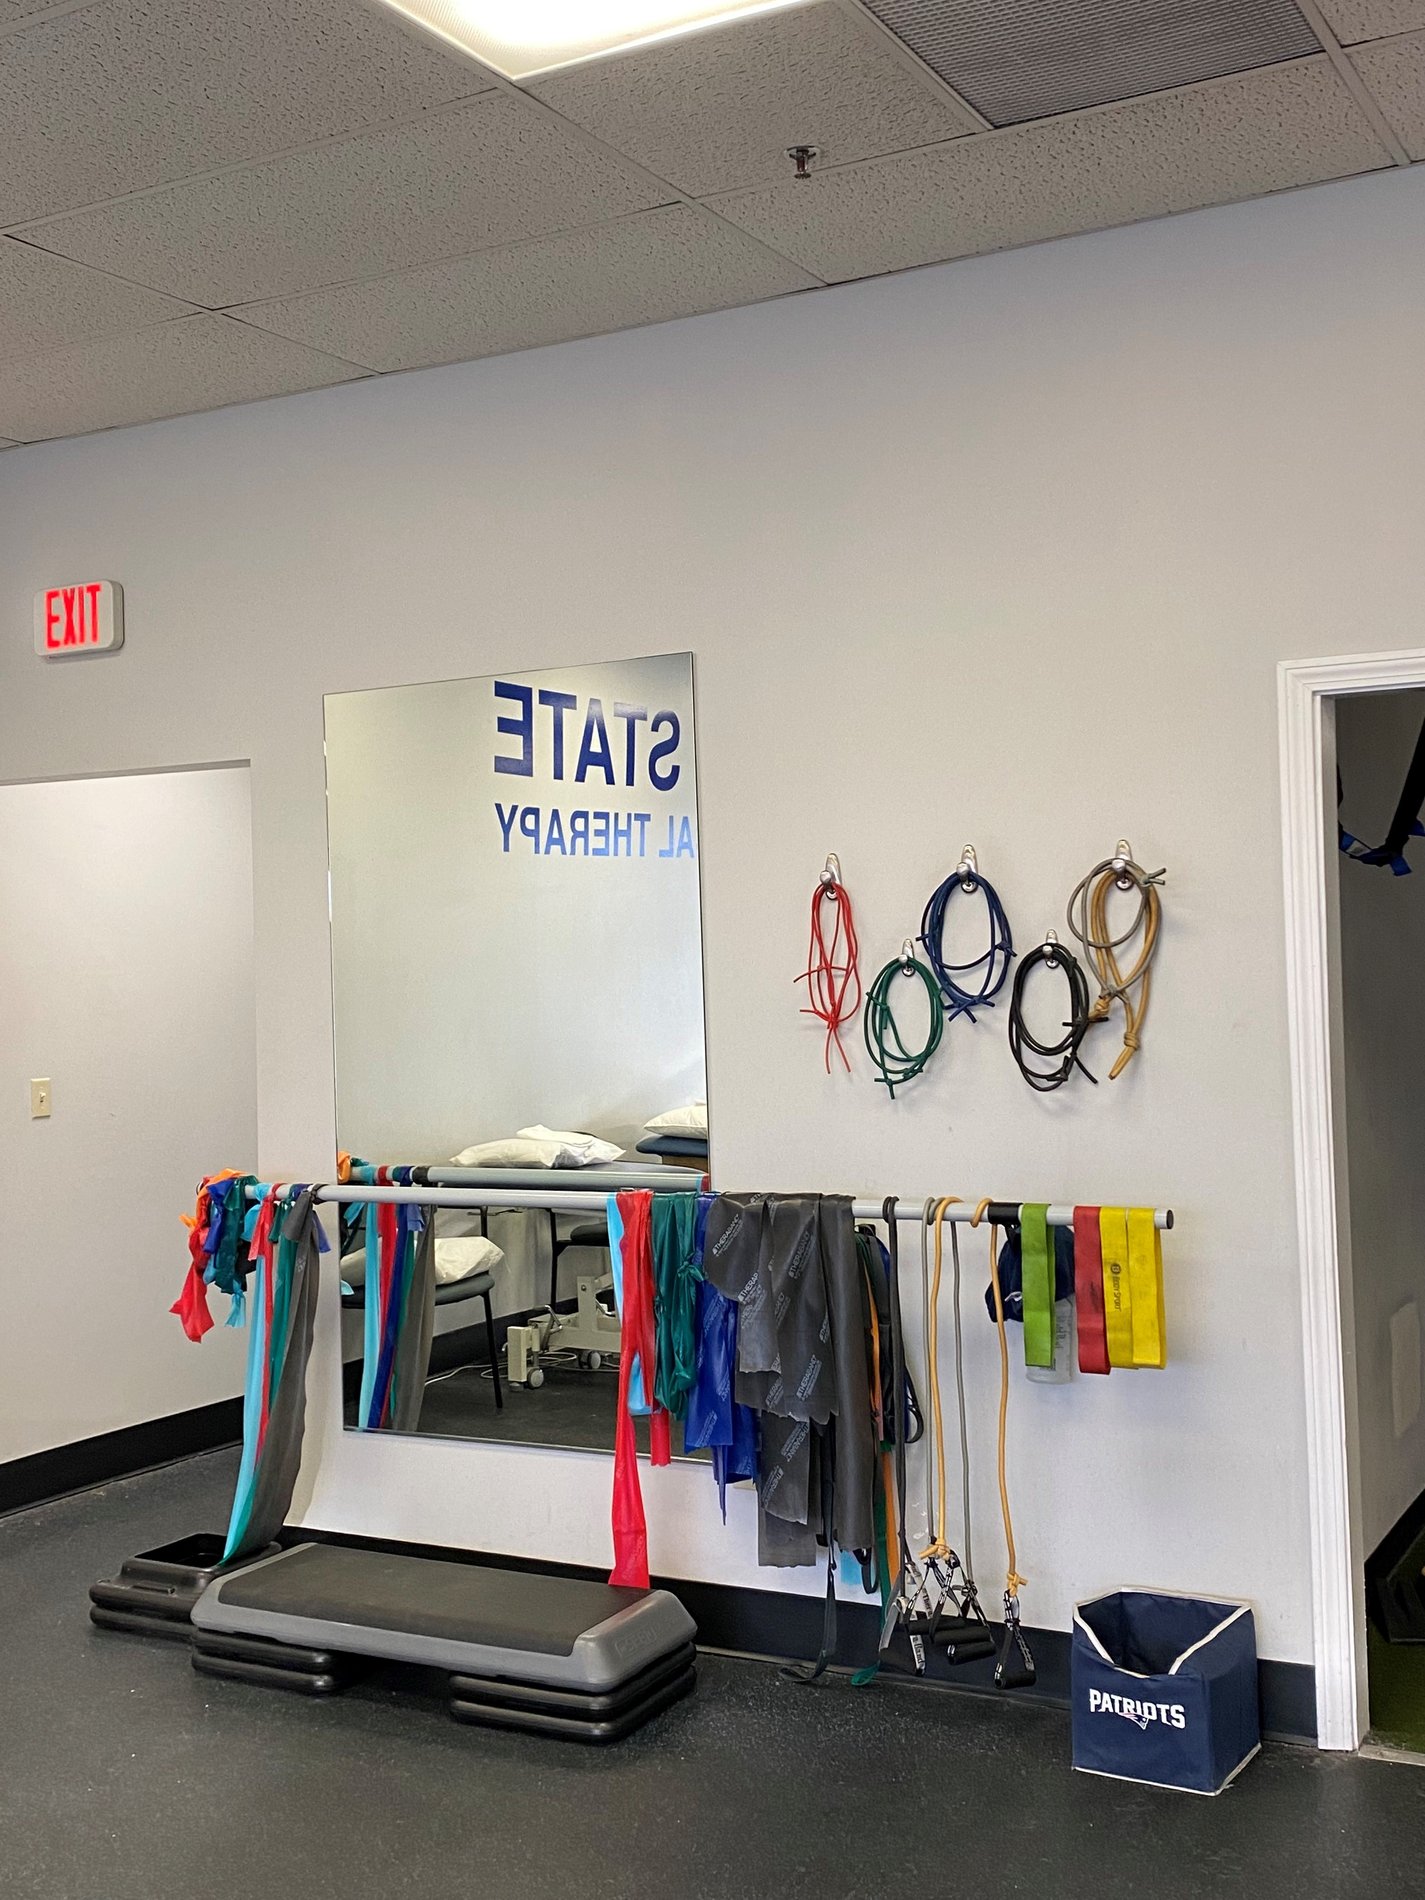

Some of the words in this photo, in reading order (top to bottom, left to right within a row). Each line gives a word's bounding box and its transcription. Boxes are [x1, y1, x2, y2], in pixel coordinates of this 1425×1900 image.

[46, 584, 101, 649] EXIT
[714, 1214, 739, 1250] THERABAND
[797, 1356, 818, 1393] THERABAND
[1089, 1688, 1186, 1729] PATRIOTS
